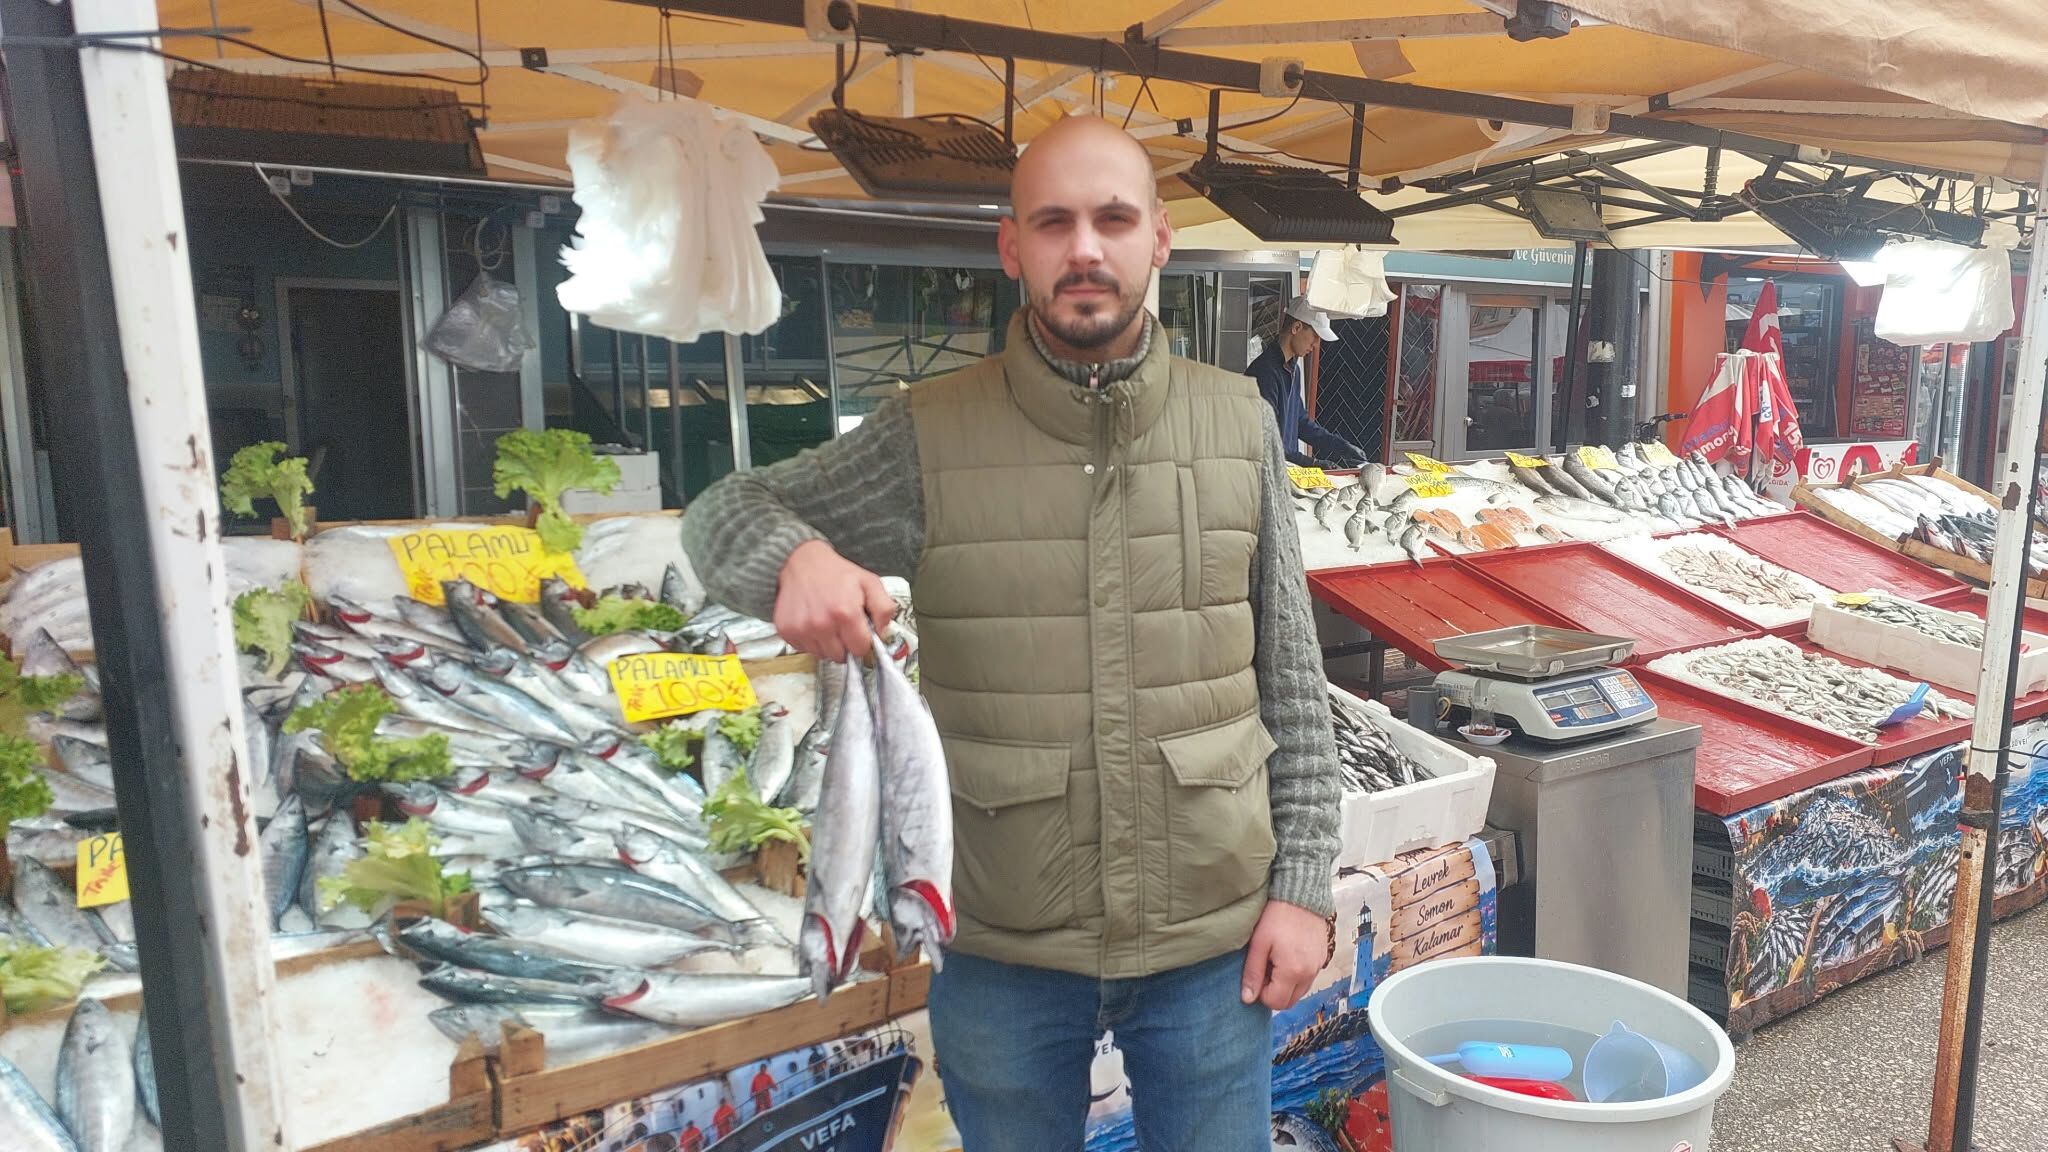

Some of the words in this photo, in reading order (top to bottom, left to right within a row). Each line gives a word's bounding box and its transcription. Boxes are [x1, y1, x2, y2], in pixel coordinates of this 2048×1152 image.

[615, 657, 727, 681] PALAMUT
[1940, 752, 1955, 768] VEFA
[1413, 859, 1450, 896] Levrek
[1417, 899, 1456, 926] Somon
[1413, 925, 1464, 959] Kalamar
[800, 1113, 856, 1151] VEFA
